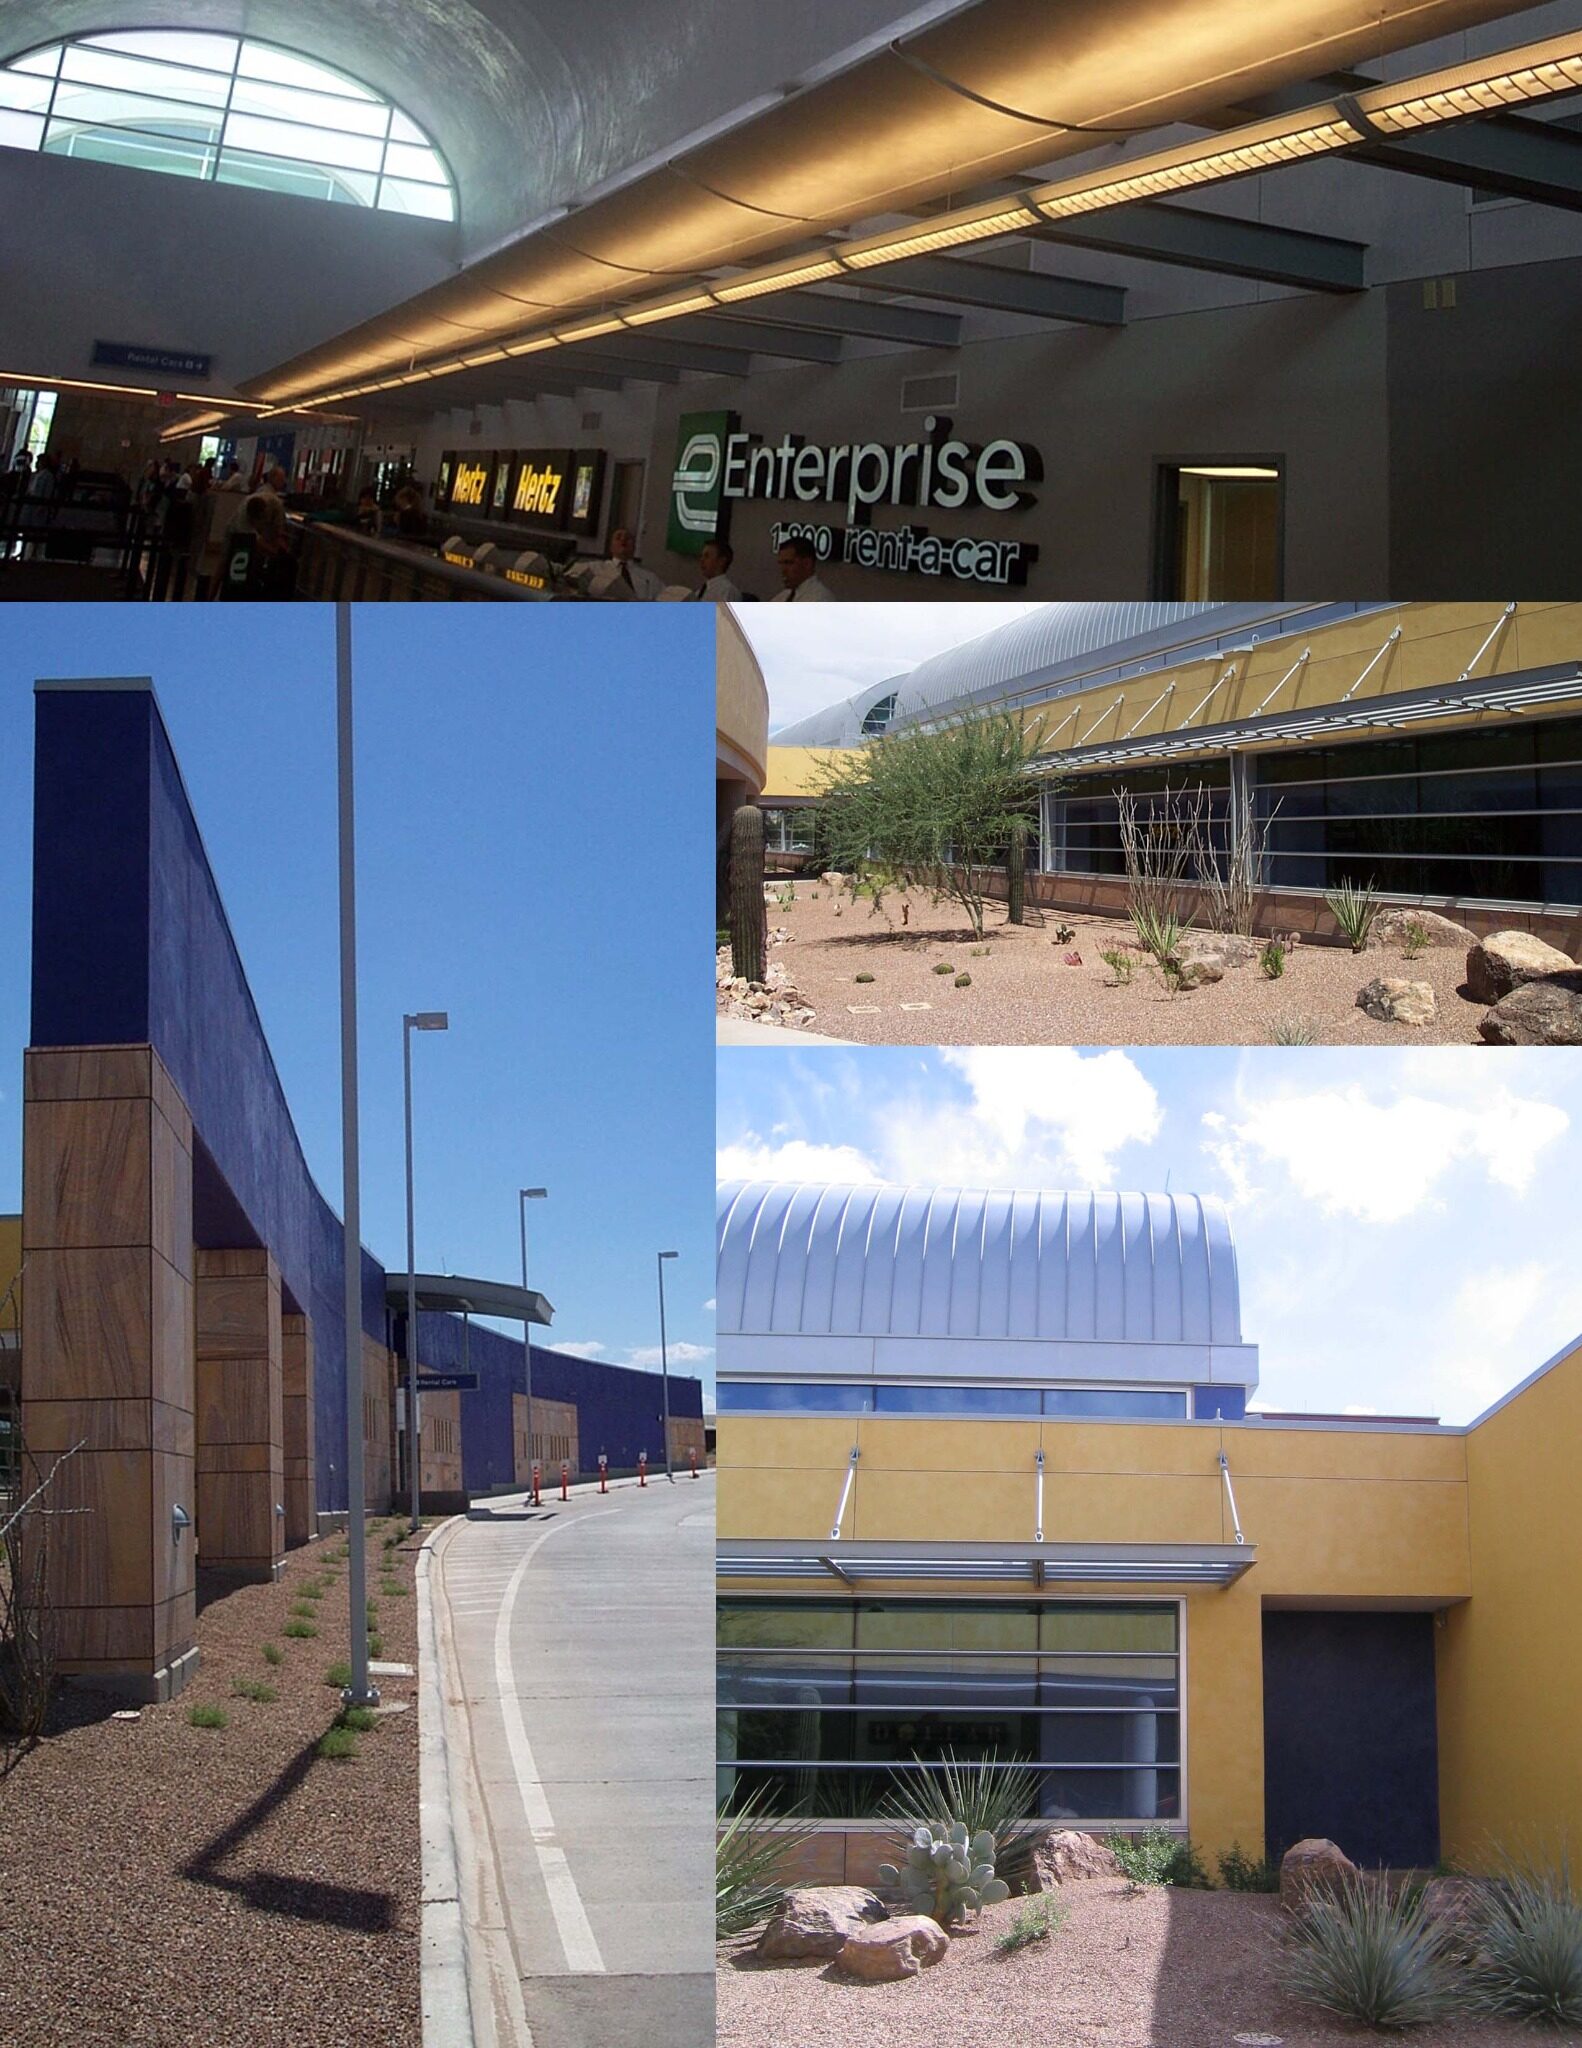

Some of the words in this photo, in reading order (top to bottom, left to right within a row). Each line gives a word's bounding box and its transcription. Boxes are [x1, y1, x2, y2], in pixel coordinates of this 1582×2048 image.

[451, 462, 488, 505] Hertz
[513, 463, 563, 515] Hertz
[723, 415, 1026, 524] Enterprise
[844, 525, 1020, 584] rent-a-car
